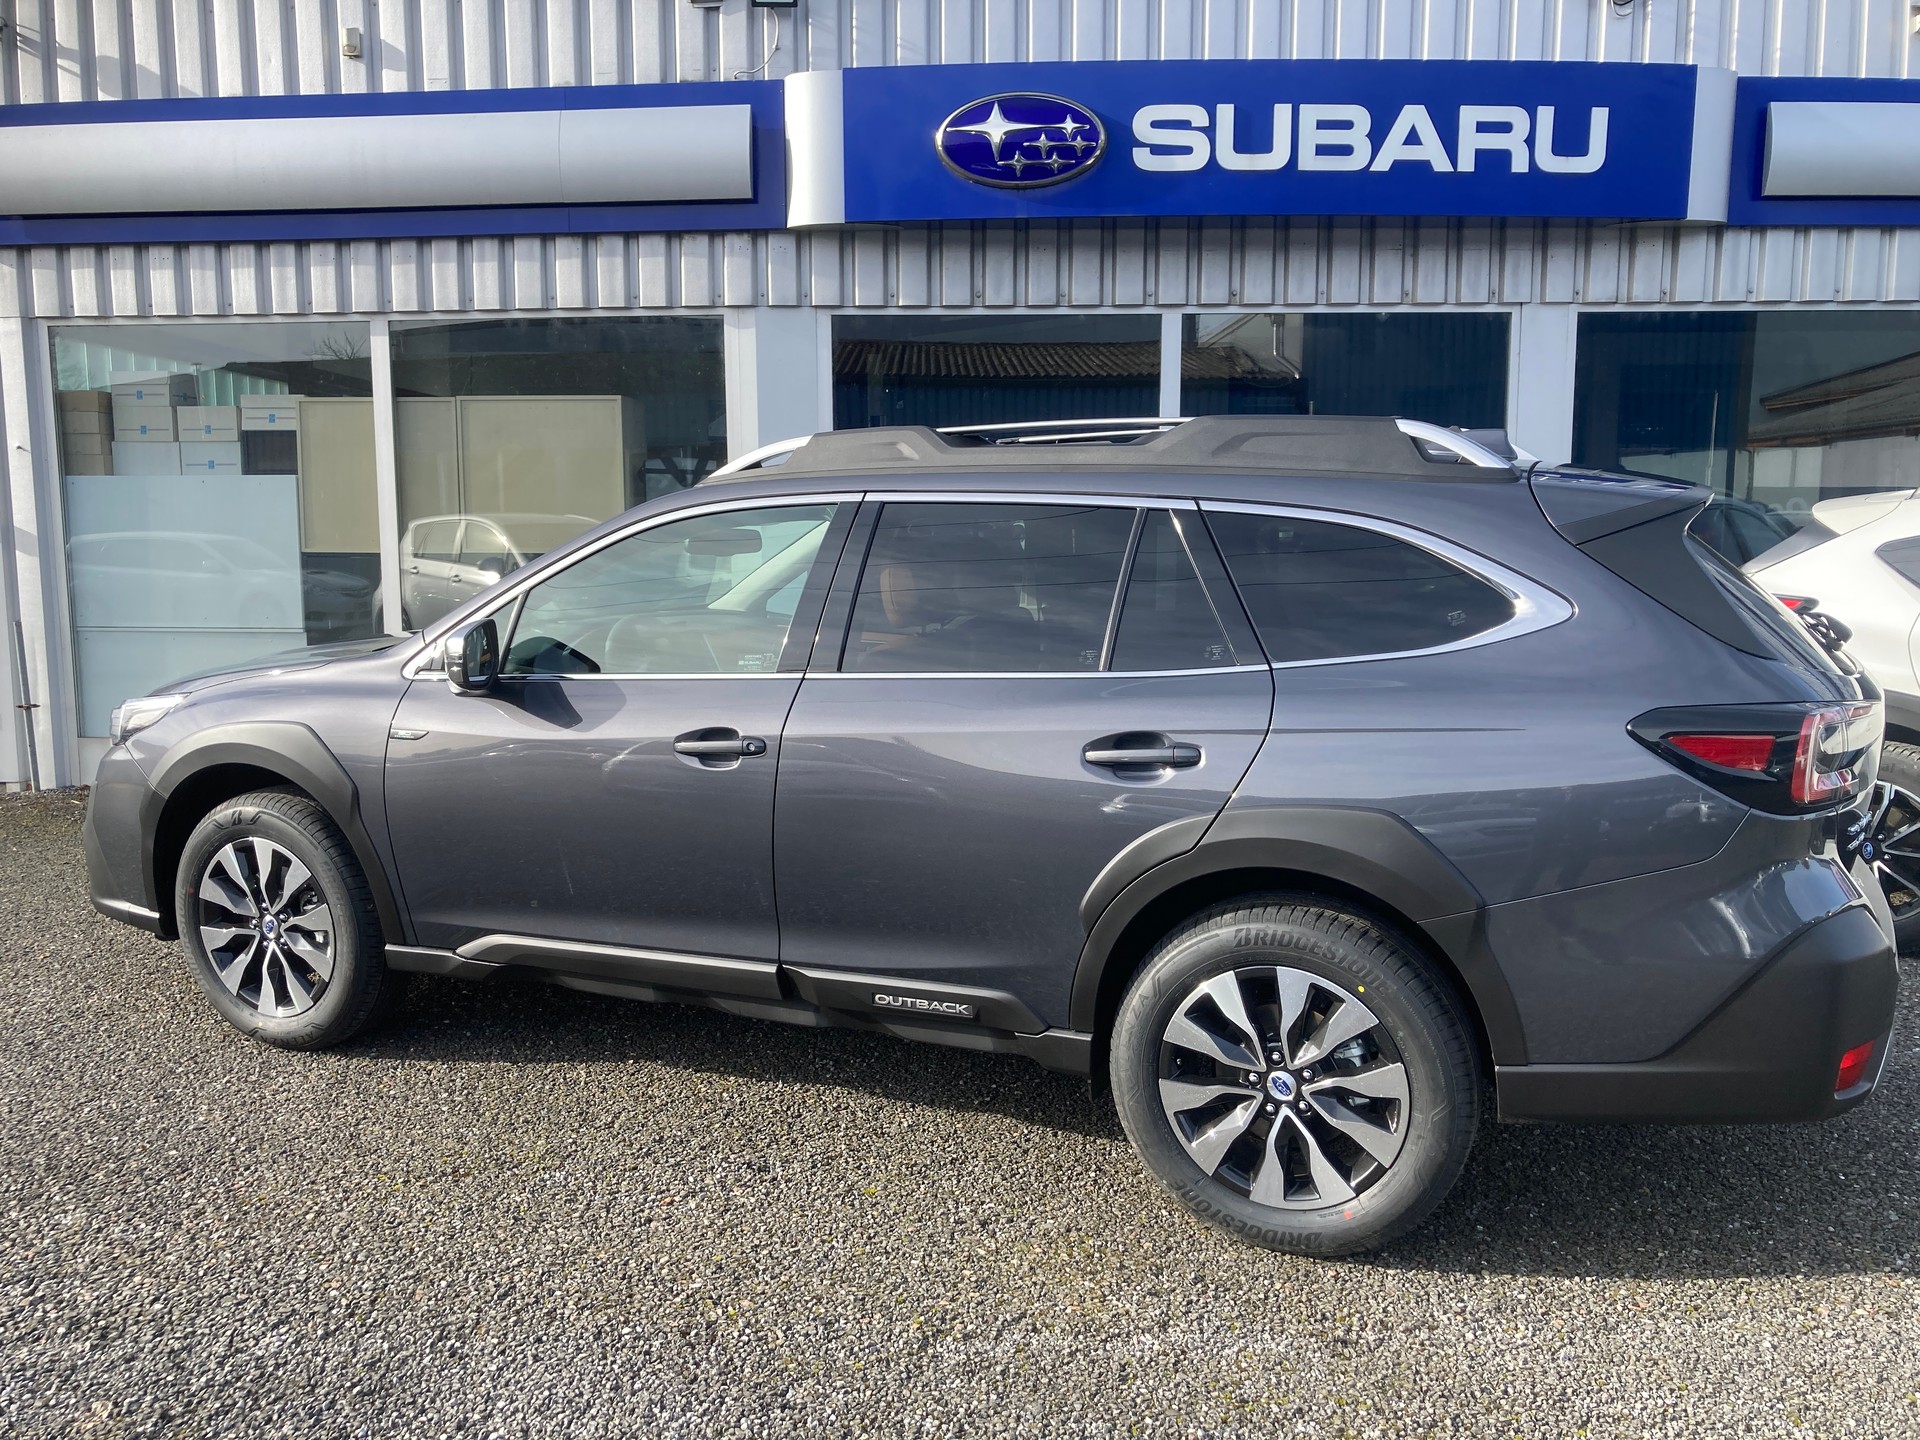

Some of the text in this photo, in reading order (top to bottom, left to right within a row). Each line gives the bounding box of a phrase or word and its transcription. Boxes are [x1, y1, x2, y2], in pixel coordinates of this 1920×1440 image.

[1132, 104, 1609, 173] SUBARU
[1233, 927, 1395, 997] BRIDGESTONE
[874, 994, 970, 1015] OUTBACK
[1170, 1178, 1323, 1249] BRIDGESTONE
